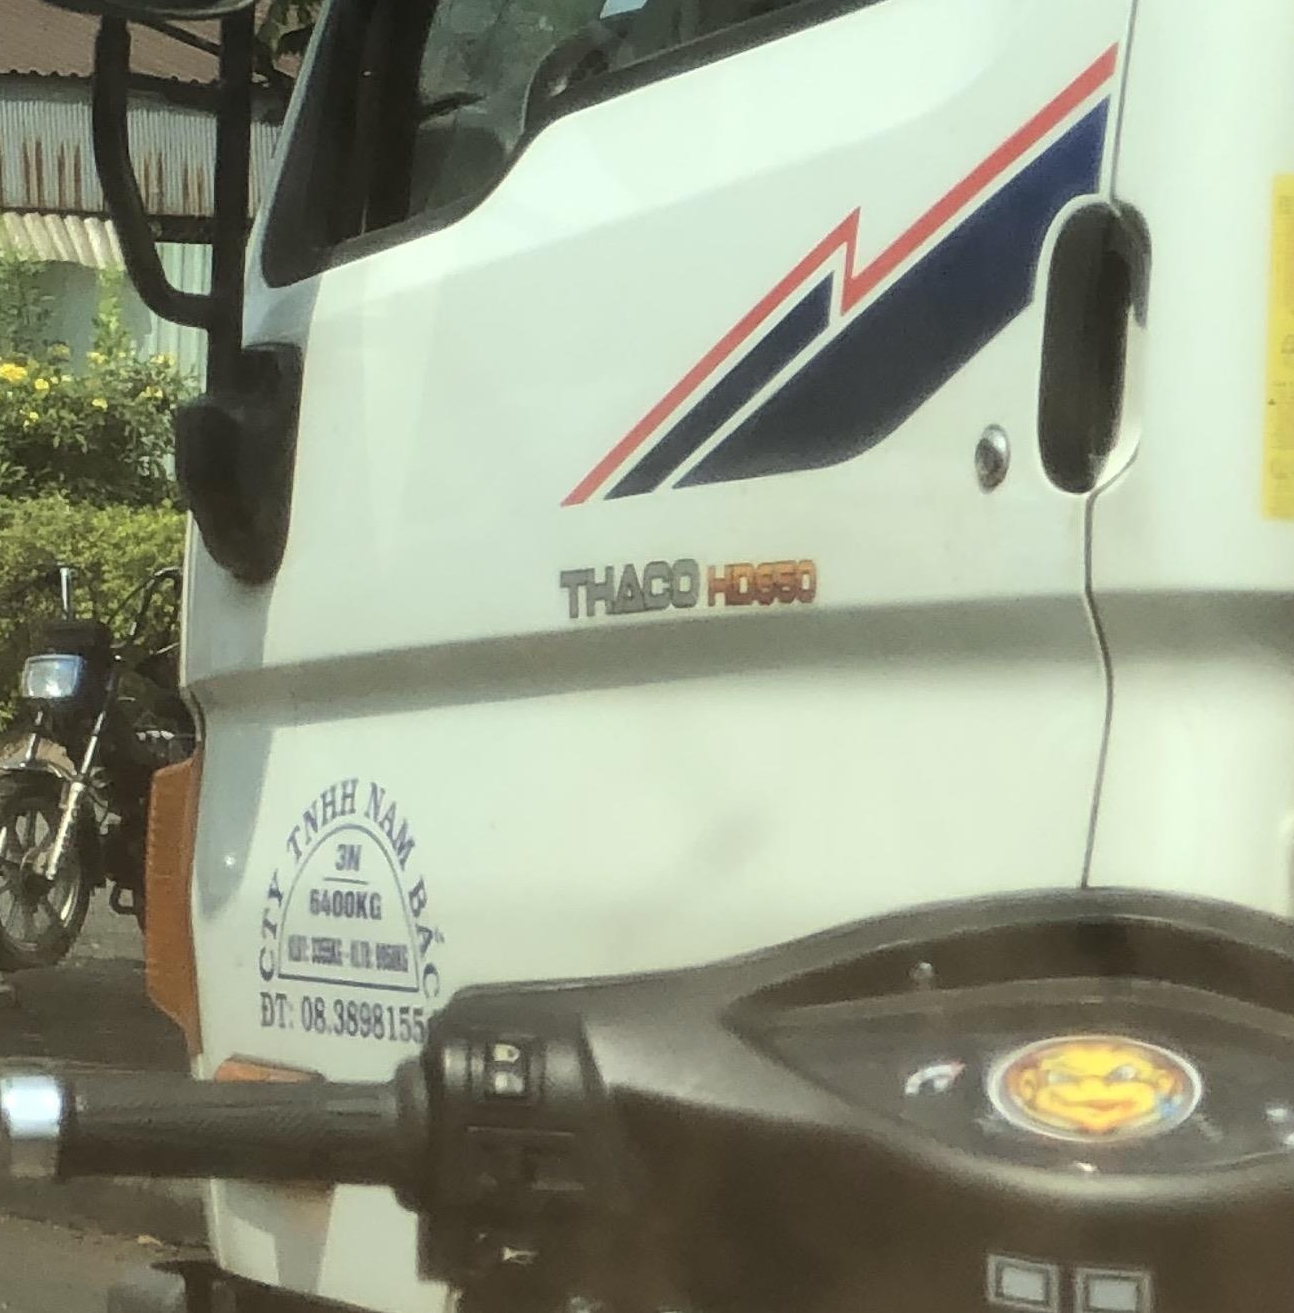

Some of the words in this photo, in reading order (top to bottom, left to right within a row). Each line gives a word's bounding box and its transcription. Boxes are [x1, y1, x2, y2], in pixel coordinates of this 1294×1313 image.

[560, 558, 700, 619] THACO
[287, 778, 359, 863] TNHH
[364, 781, 416, 872] NAM
[301, 995, 428, 1044] 08.3898155
